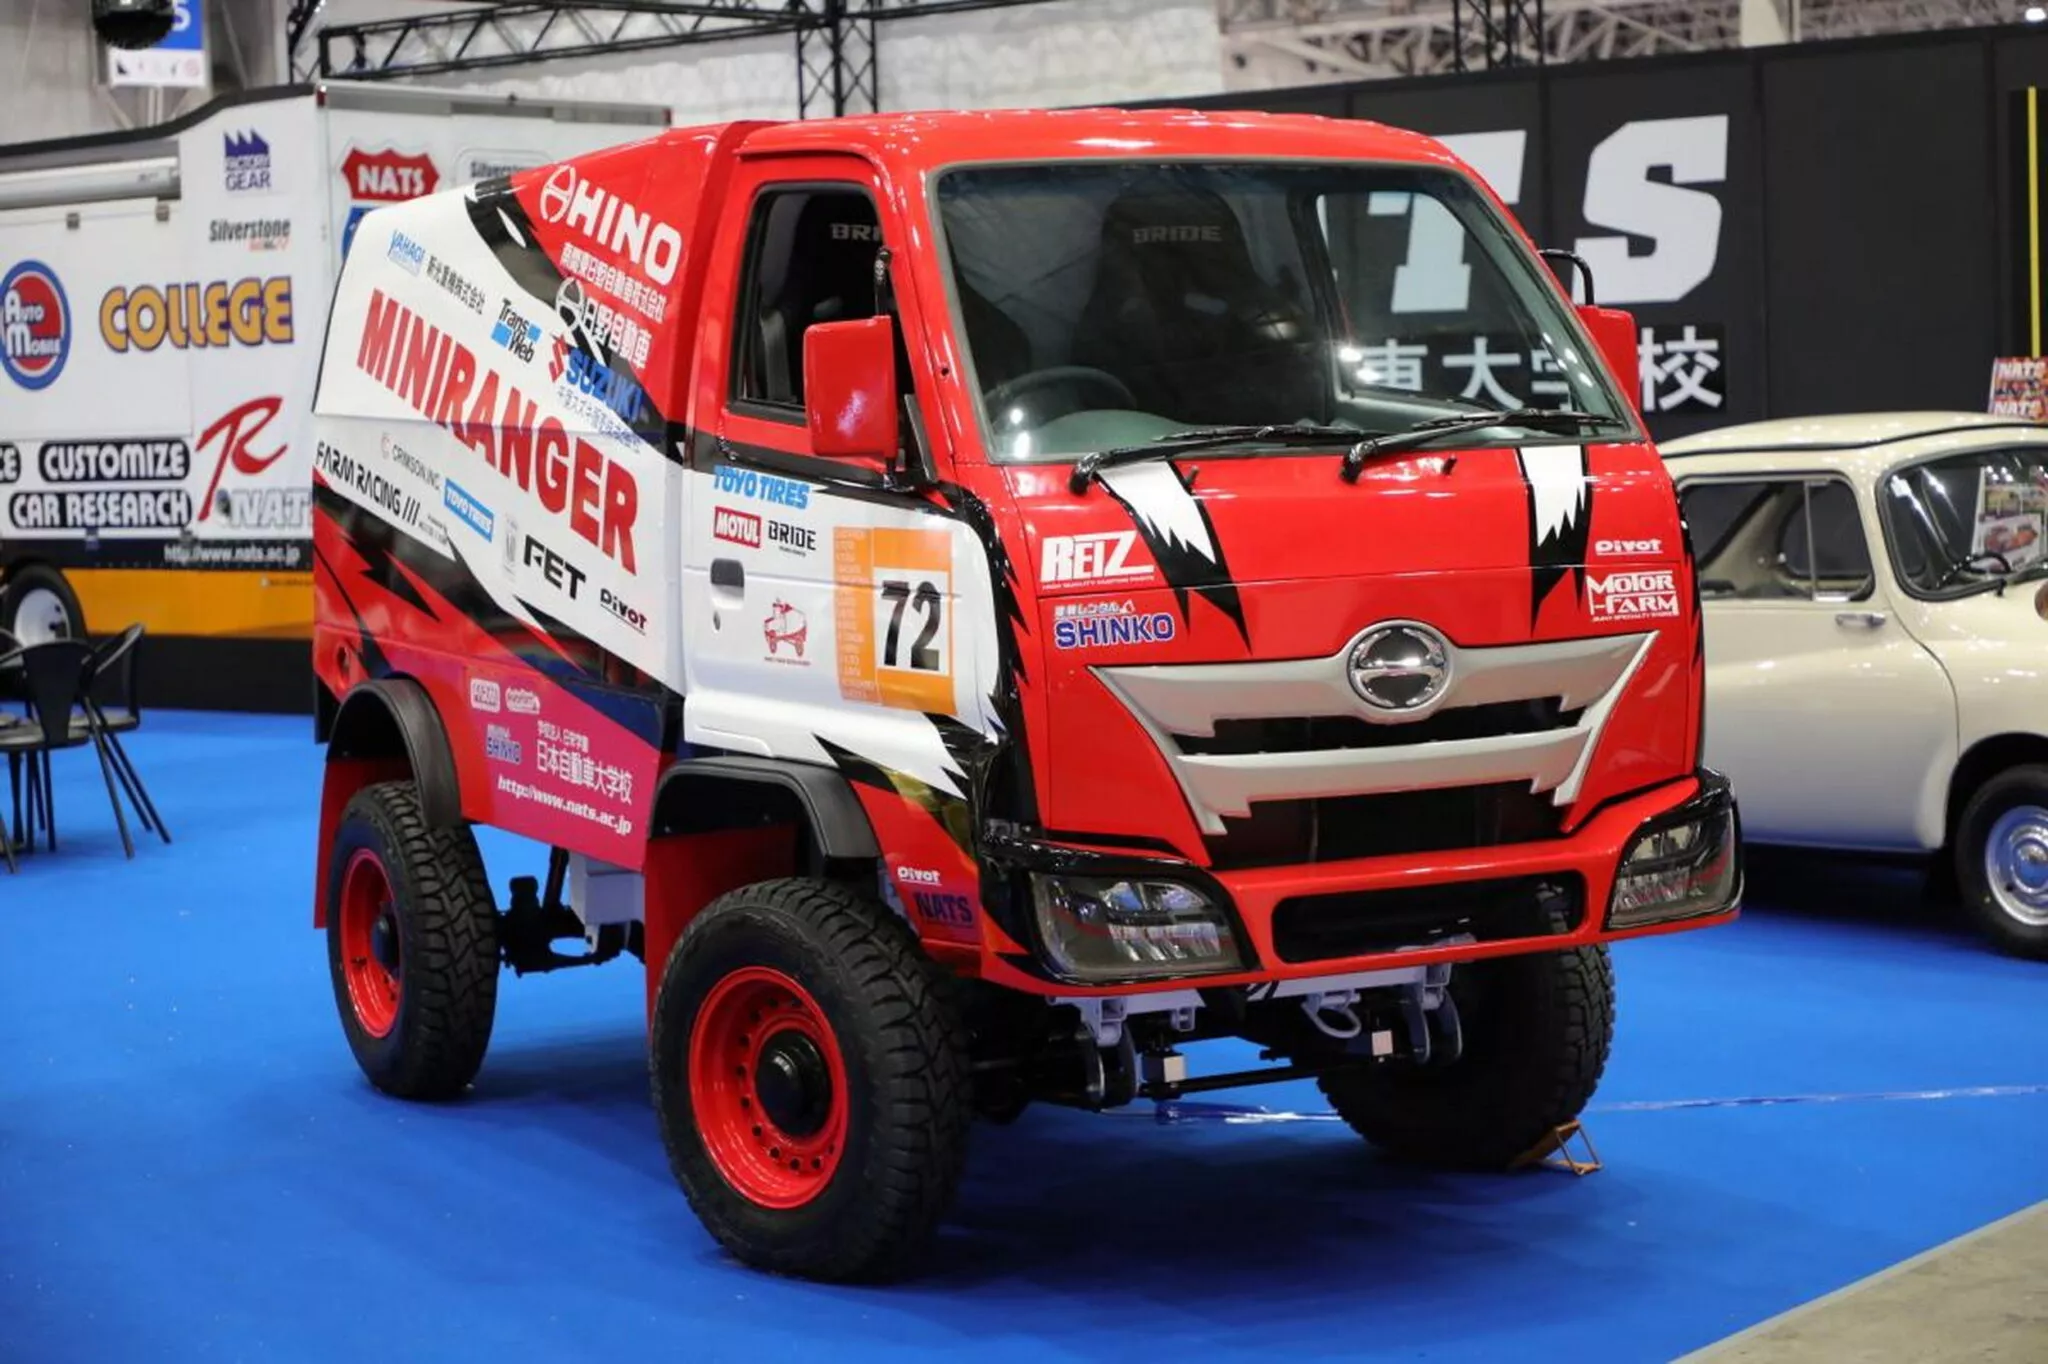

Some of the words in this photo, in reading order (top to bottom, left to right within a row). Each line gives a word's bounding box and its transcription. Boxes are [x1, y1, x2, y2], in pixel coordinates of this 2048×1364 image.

[225, 171, 271, 191] GEAR
[357, 164, 425, 195] NATS
[209, 218, 291, 242] Silverstone
[568, 178, 682, 286] HINO
[1132, 225, 1222, 243] BRIDE
[100, 276, 294, 352] COLLEGE
[498, 298, 530, 332] Trans
[582, 296, 653, 369] 日野自動車
[508, 329, 535, 364] Web
[566, 345, 643, 425] SUZUKI
[357, 285, 639, 576] MINIRANGER
[44, 443, 186, 480] CUSTOMIZE
[315, 440, 355, 487] FARM
[356, 464, 402, 516] RACING
[714, 463, 757, 498] TOYO
[758, 475, 812, 510] TIRES
[13, 493, 60, 528] CAR
[66, 490, 189, 527] RESEARCH
[715, 510, 761, 546] MOTUL
[768, 520, 816, 551] BRIDE
[523, 534, 587, 600] FET
[1040, 530, 1155, 583] REIZ
[1586, 570, 1676, 596] MOTOR
[881, 580, 942, 671] 72
[1055, 612, 1175, 650] SHINKO
[537, 738, 632, 806] 日本自動車大学校
[497, 774, 633, 836] http://www.nats.ac.jp
[914, 892, 974, 925] NATS
